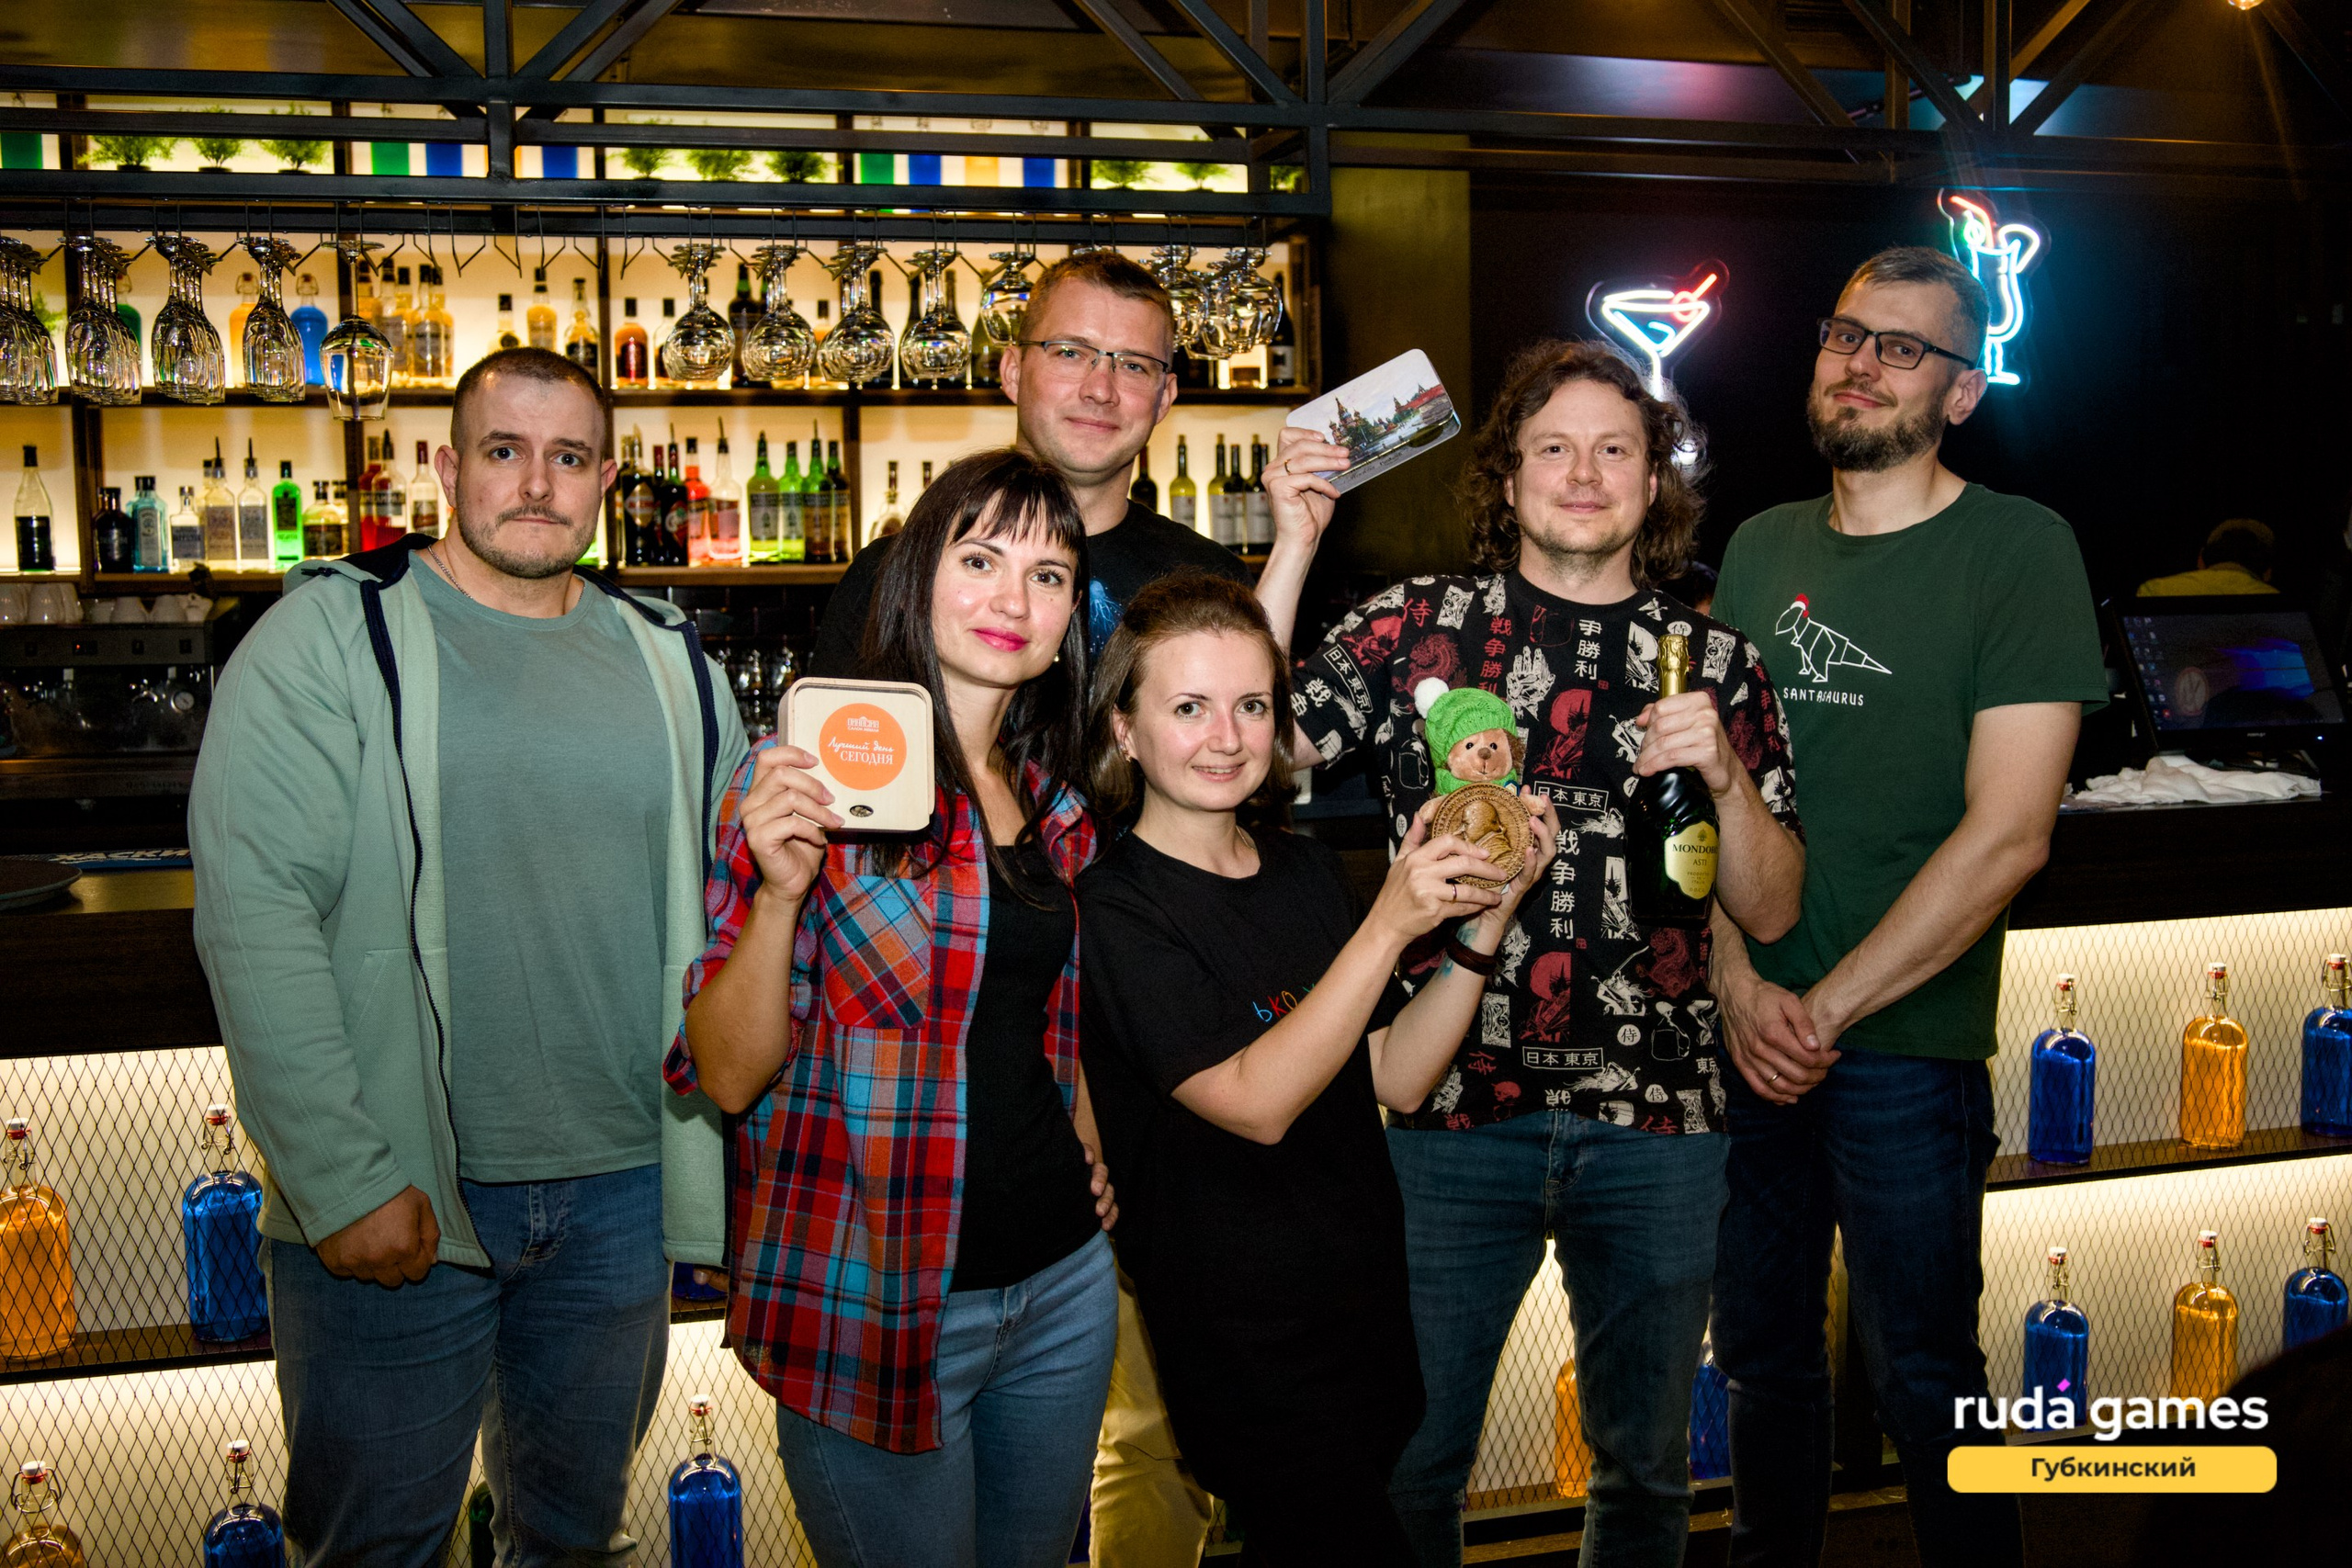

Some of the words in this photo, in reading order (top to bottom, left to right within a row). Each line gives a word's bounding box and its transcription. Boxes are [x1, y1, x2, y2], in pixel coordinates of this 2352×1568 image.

[1401, 597, 1434, 627] 侍
[828, 737, 870, 753] Лучший
[873, 739, 894, 752] день
[840, 750, 894, 766] СЕГОДНЯ
[1621, 1028, 1638, 1043] 侍
[1648, 1087, 1665, 1101] 侍
